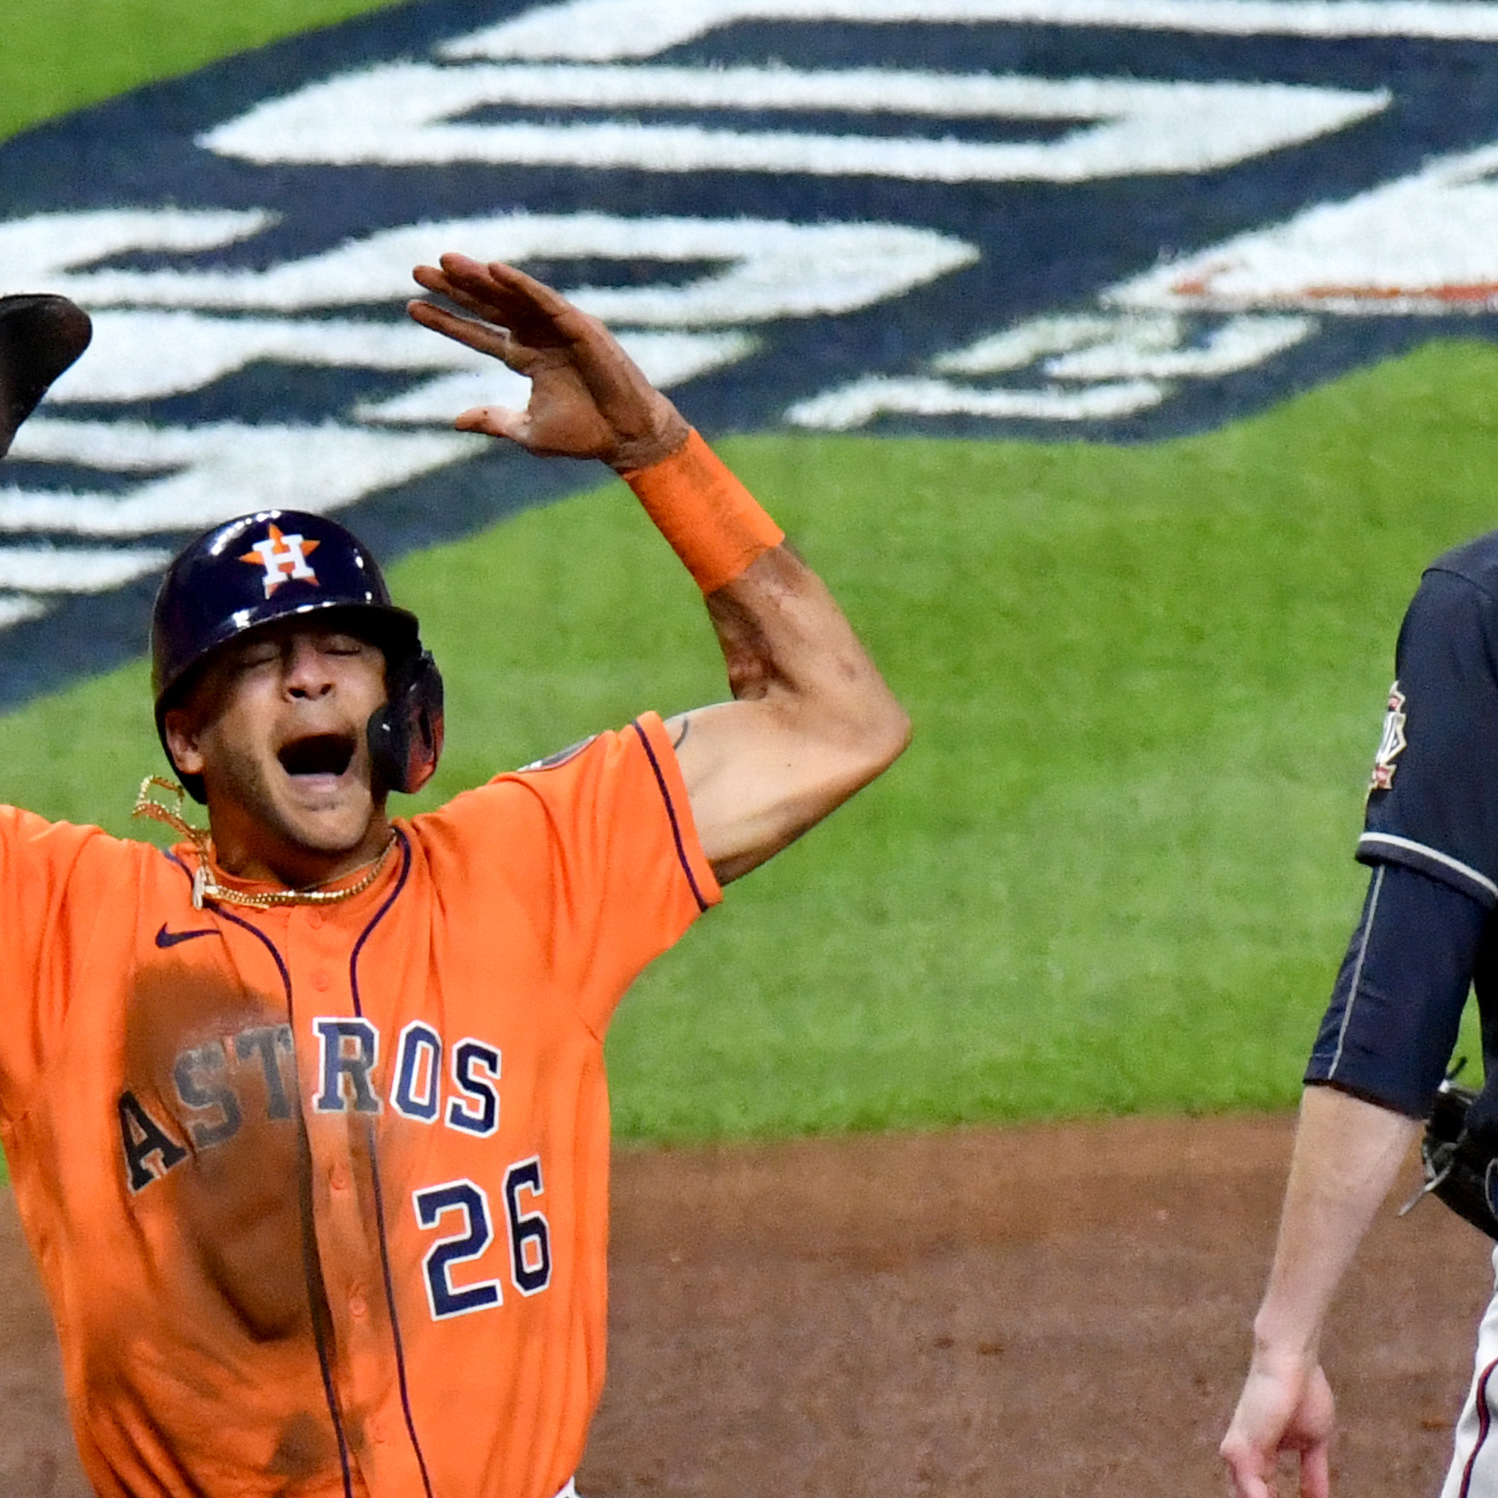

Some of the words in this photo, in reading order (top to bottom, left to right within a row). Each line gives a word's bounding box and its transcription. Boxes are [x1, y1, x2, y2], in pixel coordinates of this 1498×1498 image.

[252, 533, 316, 588] H
[115, 1016, 502, 1197] ASTROS
[412, 1155, 552, 1322] 26
